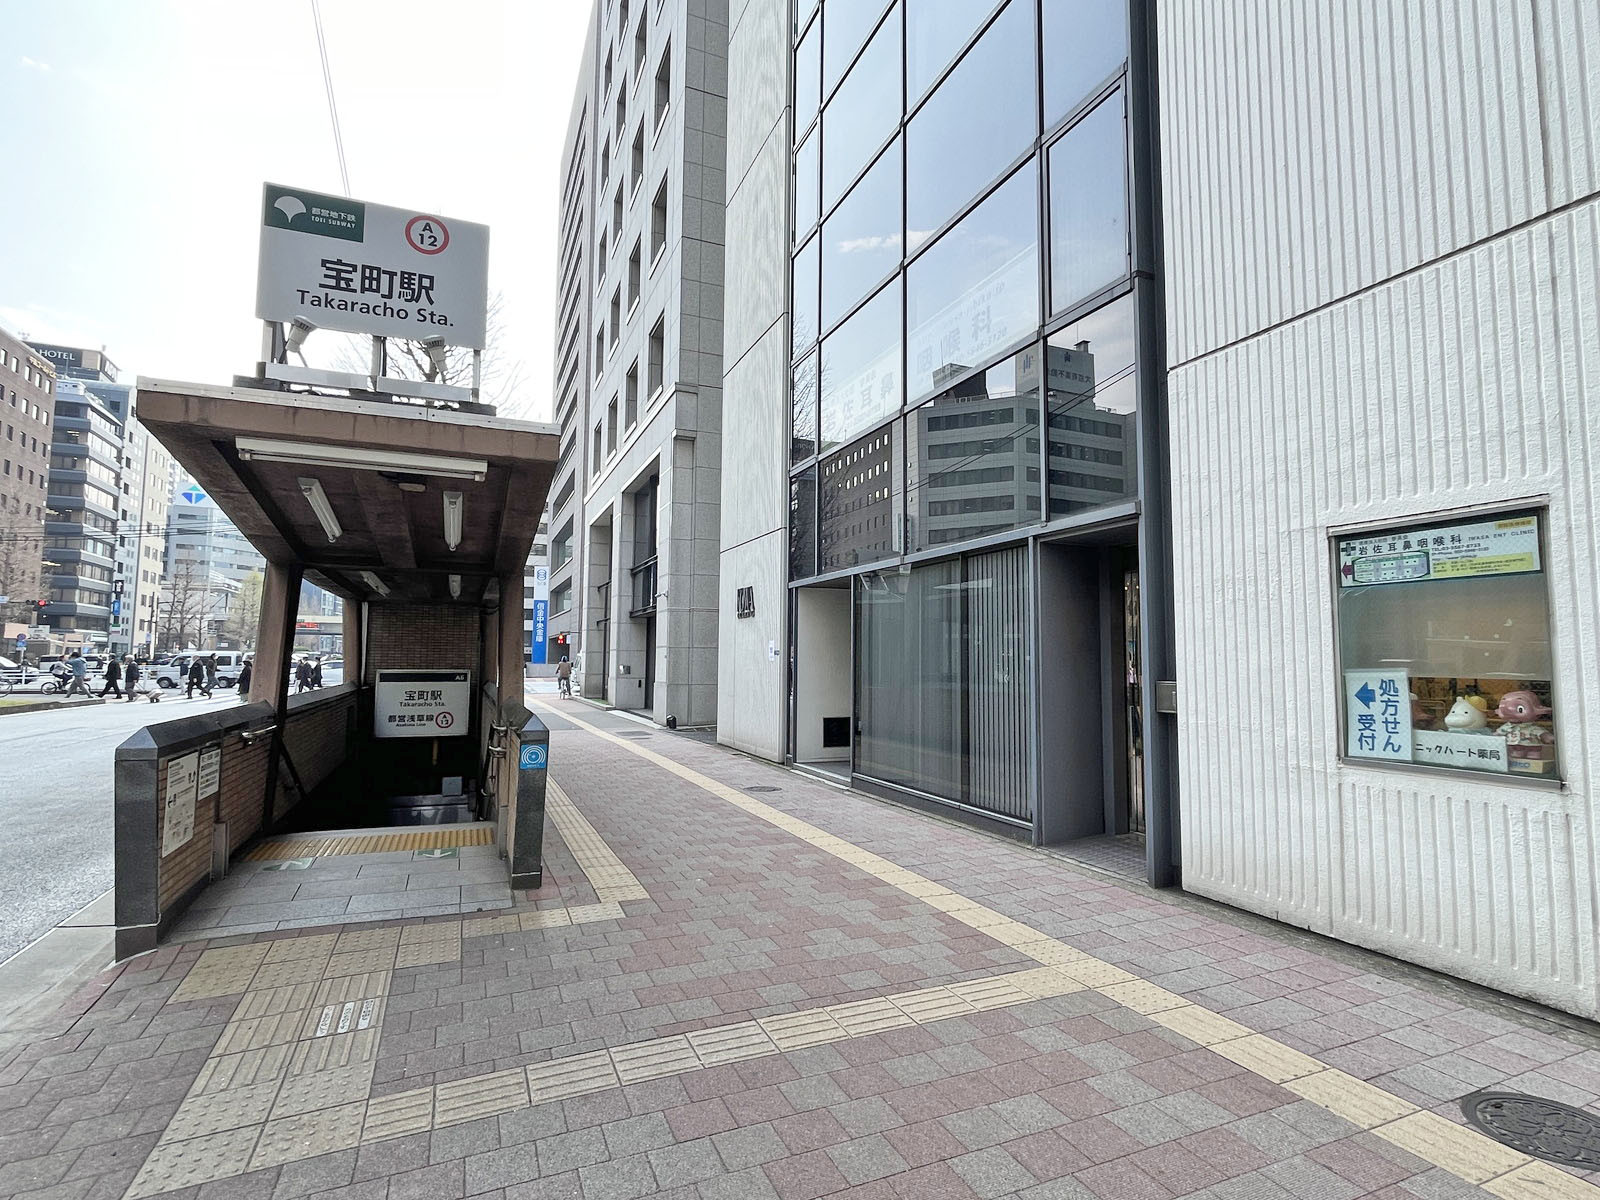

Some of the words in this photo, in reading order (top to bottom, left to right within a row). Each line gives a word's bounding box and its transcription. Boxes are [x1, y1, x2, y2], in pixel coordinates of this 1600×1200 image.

[311, 207, 356, 222] 都営地下鉄
[311, 215, 326, 224] TOEI
[328, 219, 356, 229] SUBWAY
[421, 222, 434, 234] A
[418, 233, 438, 247] 12
[318, 258, 435, 306] 宝町駅
[296, 288, 409, 320] Takaracho
[416, 308, 454, 327] Sta.
[39, 349, 75, 361] HOTEL
[1358, 533, 1463, 556] 岩佐耳鼻咽喉科
[1511, 528, 1536, 537] CLINIC
[404, 690, 443, 701] 宝町駅
[388, 714, 435, 723] 都営浅草線
[1378, 678, 1402, 753] 処方せん
[1357, 713, 1377, 752] 受付
[1414, 742, 1501, 761] ニックハート薬局
